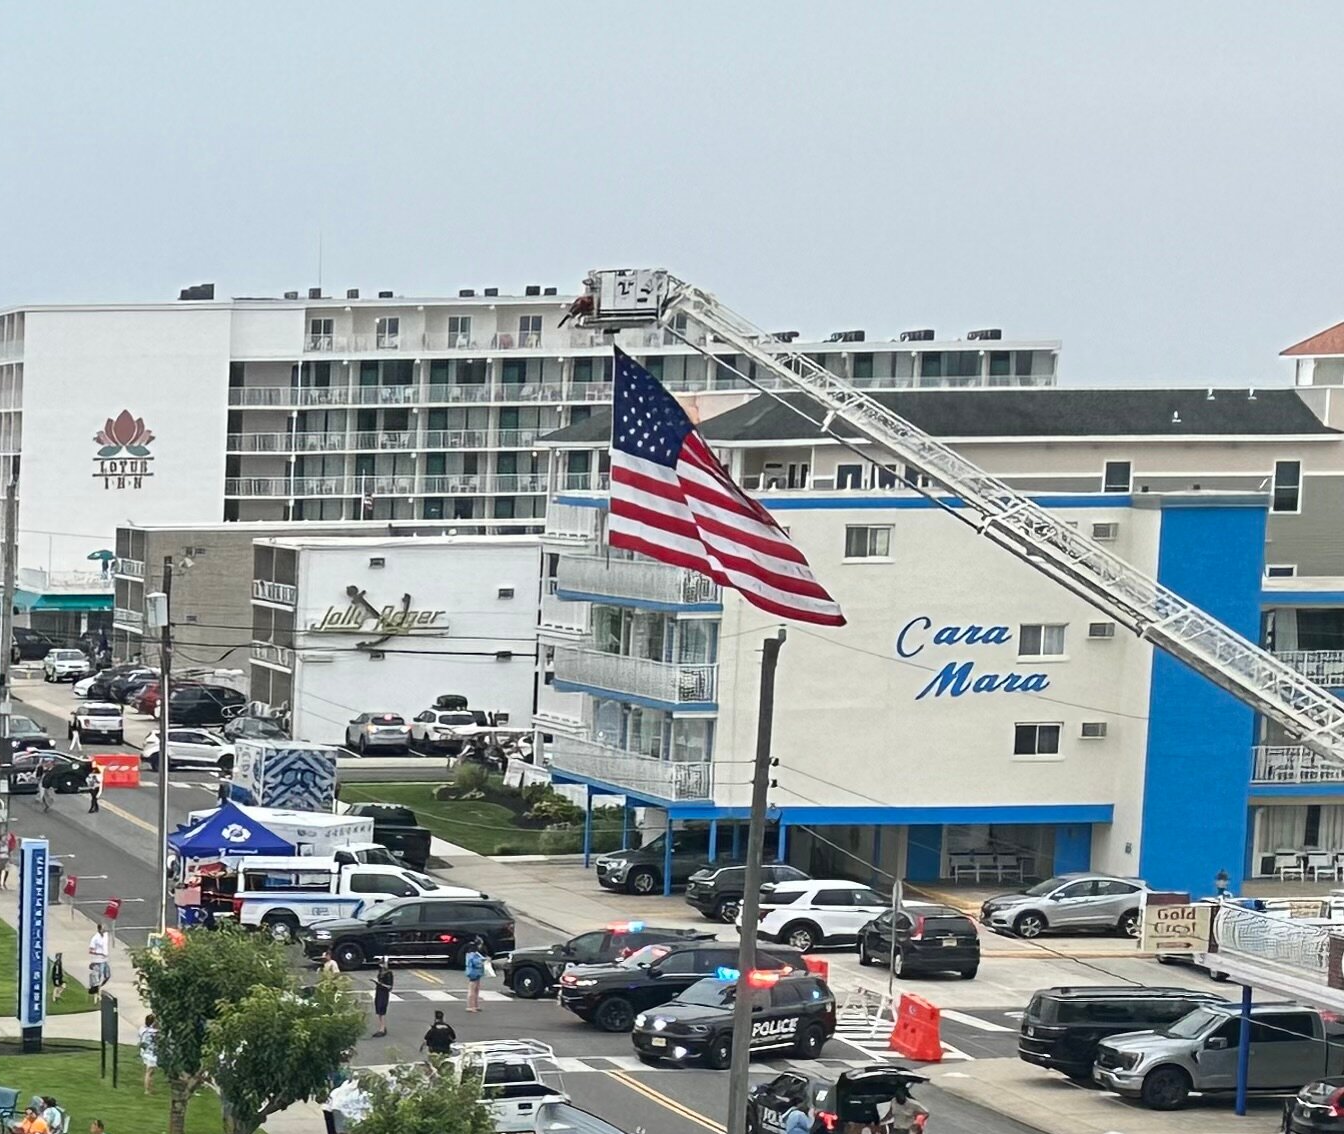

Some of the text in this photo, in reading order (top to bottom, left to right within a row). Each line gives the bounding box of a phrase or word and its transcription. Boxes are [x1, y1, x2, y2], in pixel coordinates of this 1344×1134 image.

[896, 616, 1013, 658] Cara
[915, 661, 1050, 700] Mara
[1157, 907, 1196, 920] Gold
[752, 1017, 799, 1037] POLICE
